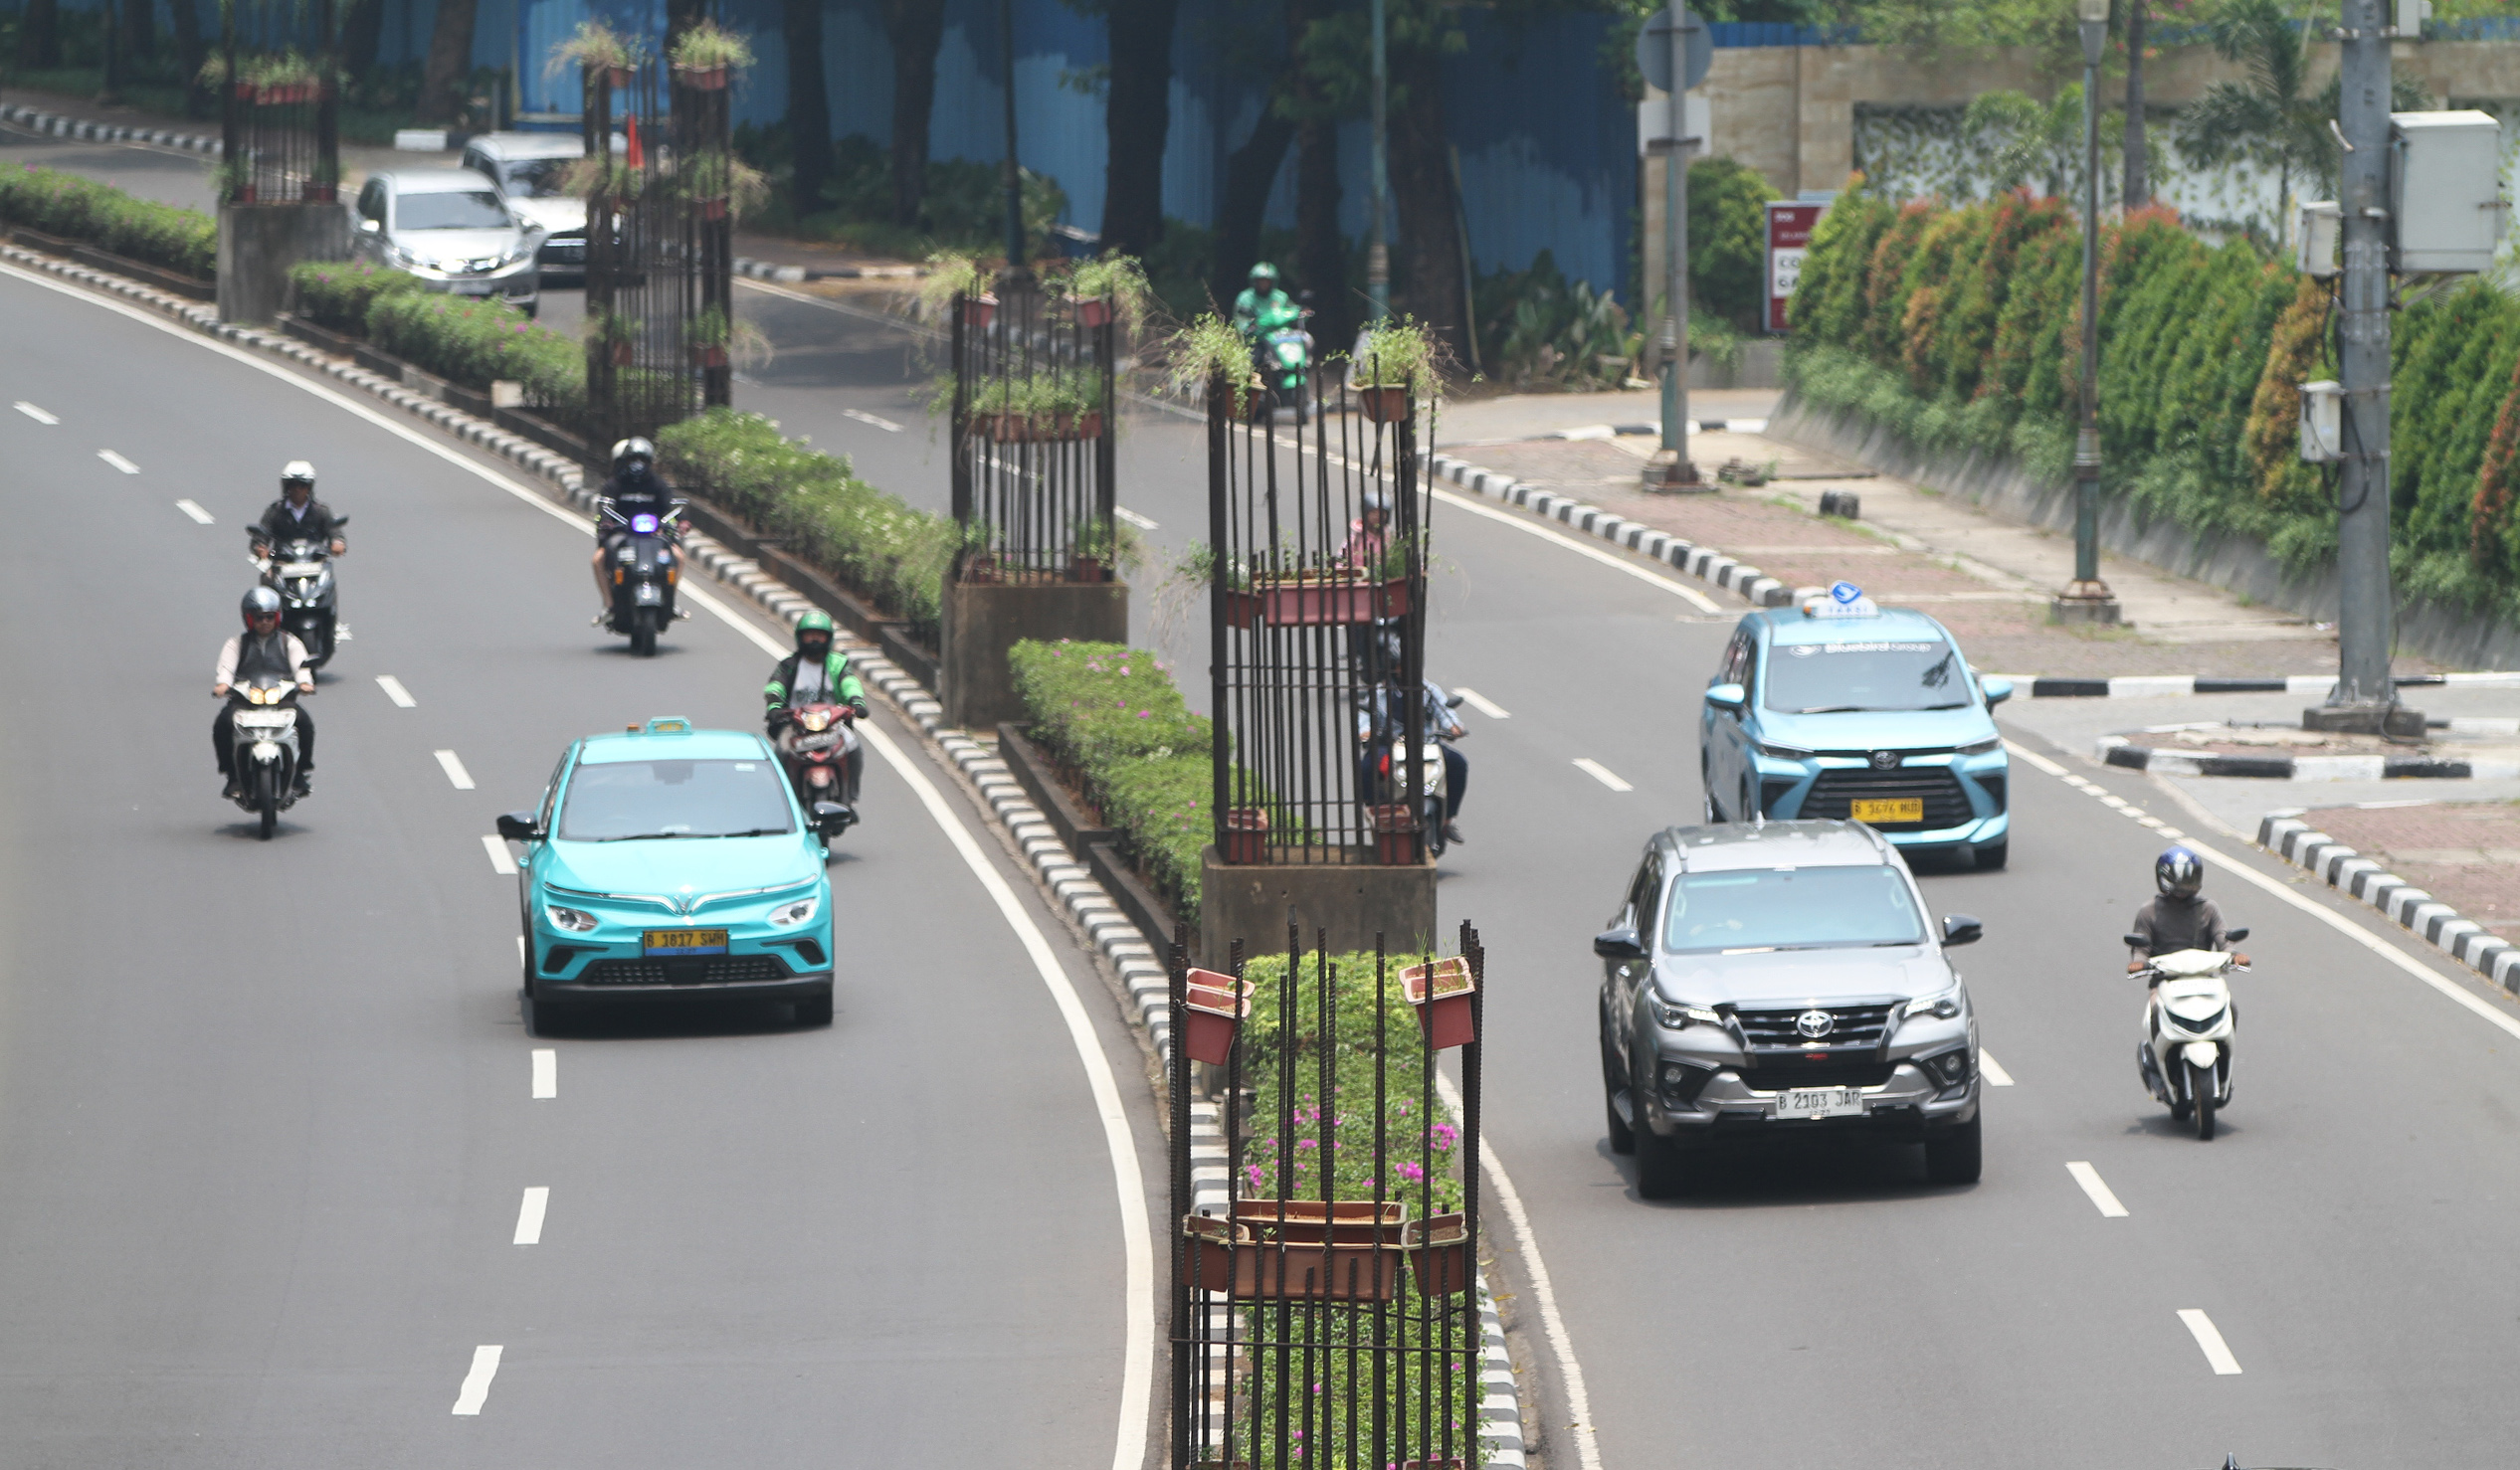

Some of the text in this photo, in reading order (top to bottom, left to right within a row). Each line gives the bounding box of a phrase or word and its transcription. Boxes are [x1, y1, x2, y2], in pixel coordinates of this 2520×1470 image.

[1825, 643, 1889, 654] Bluebird
[647, 933, 655, 948] B
[662, 932, 694, 948] 1817
[1779, 1090, 1860, 1110] B 2103 JAR
